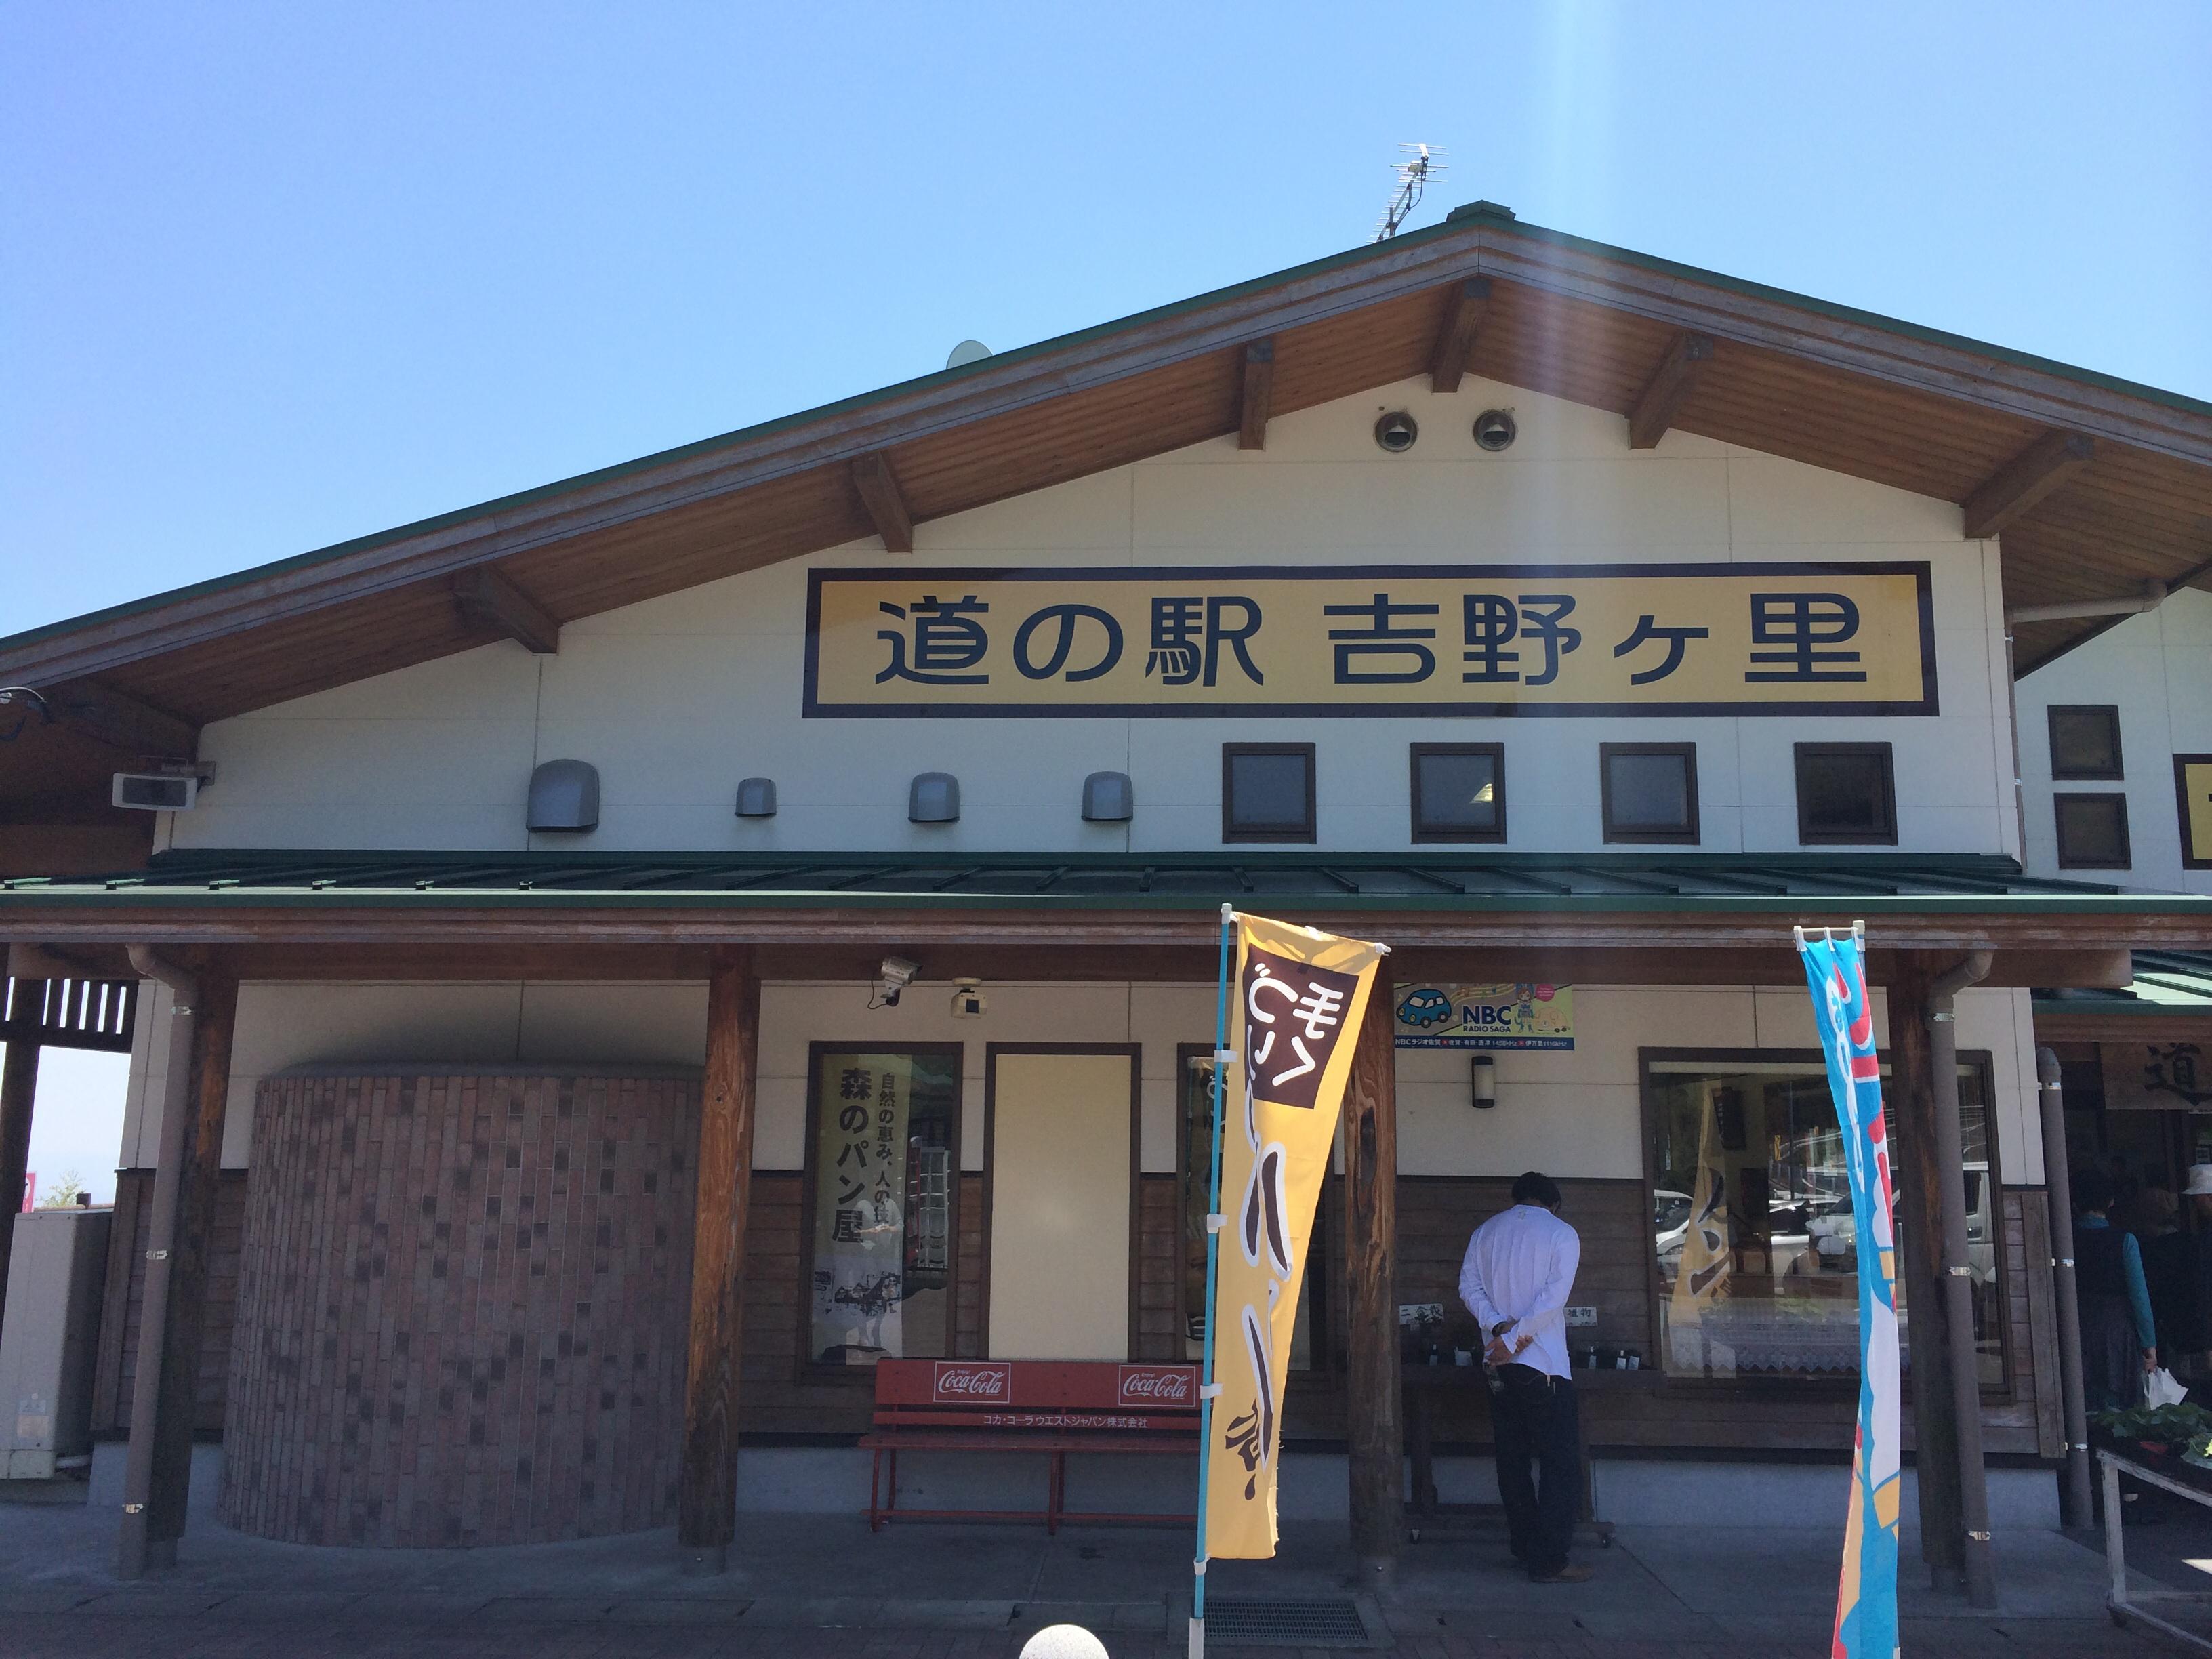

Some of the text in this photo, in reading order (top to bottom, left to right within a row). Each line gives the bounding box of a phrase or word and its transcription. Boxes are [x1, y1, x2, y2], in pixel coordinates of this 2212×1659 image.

[875, 594, 1265, 686] 道の駅
[1462, 1005, 1511, 1025] NBC
[2144, 1043, 2212, 1107] 道
[832, 1067, 873, 1244] 森のパン屋
[938, 1370, 1006, 1394] Coca-Cola
[1122, 1373, 1192, 1397] Coca-Cola
